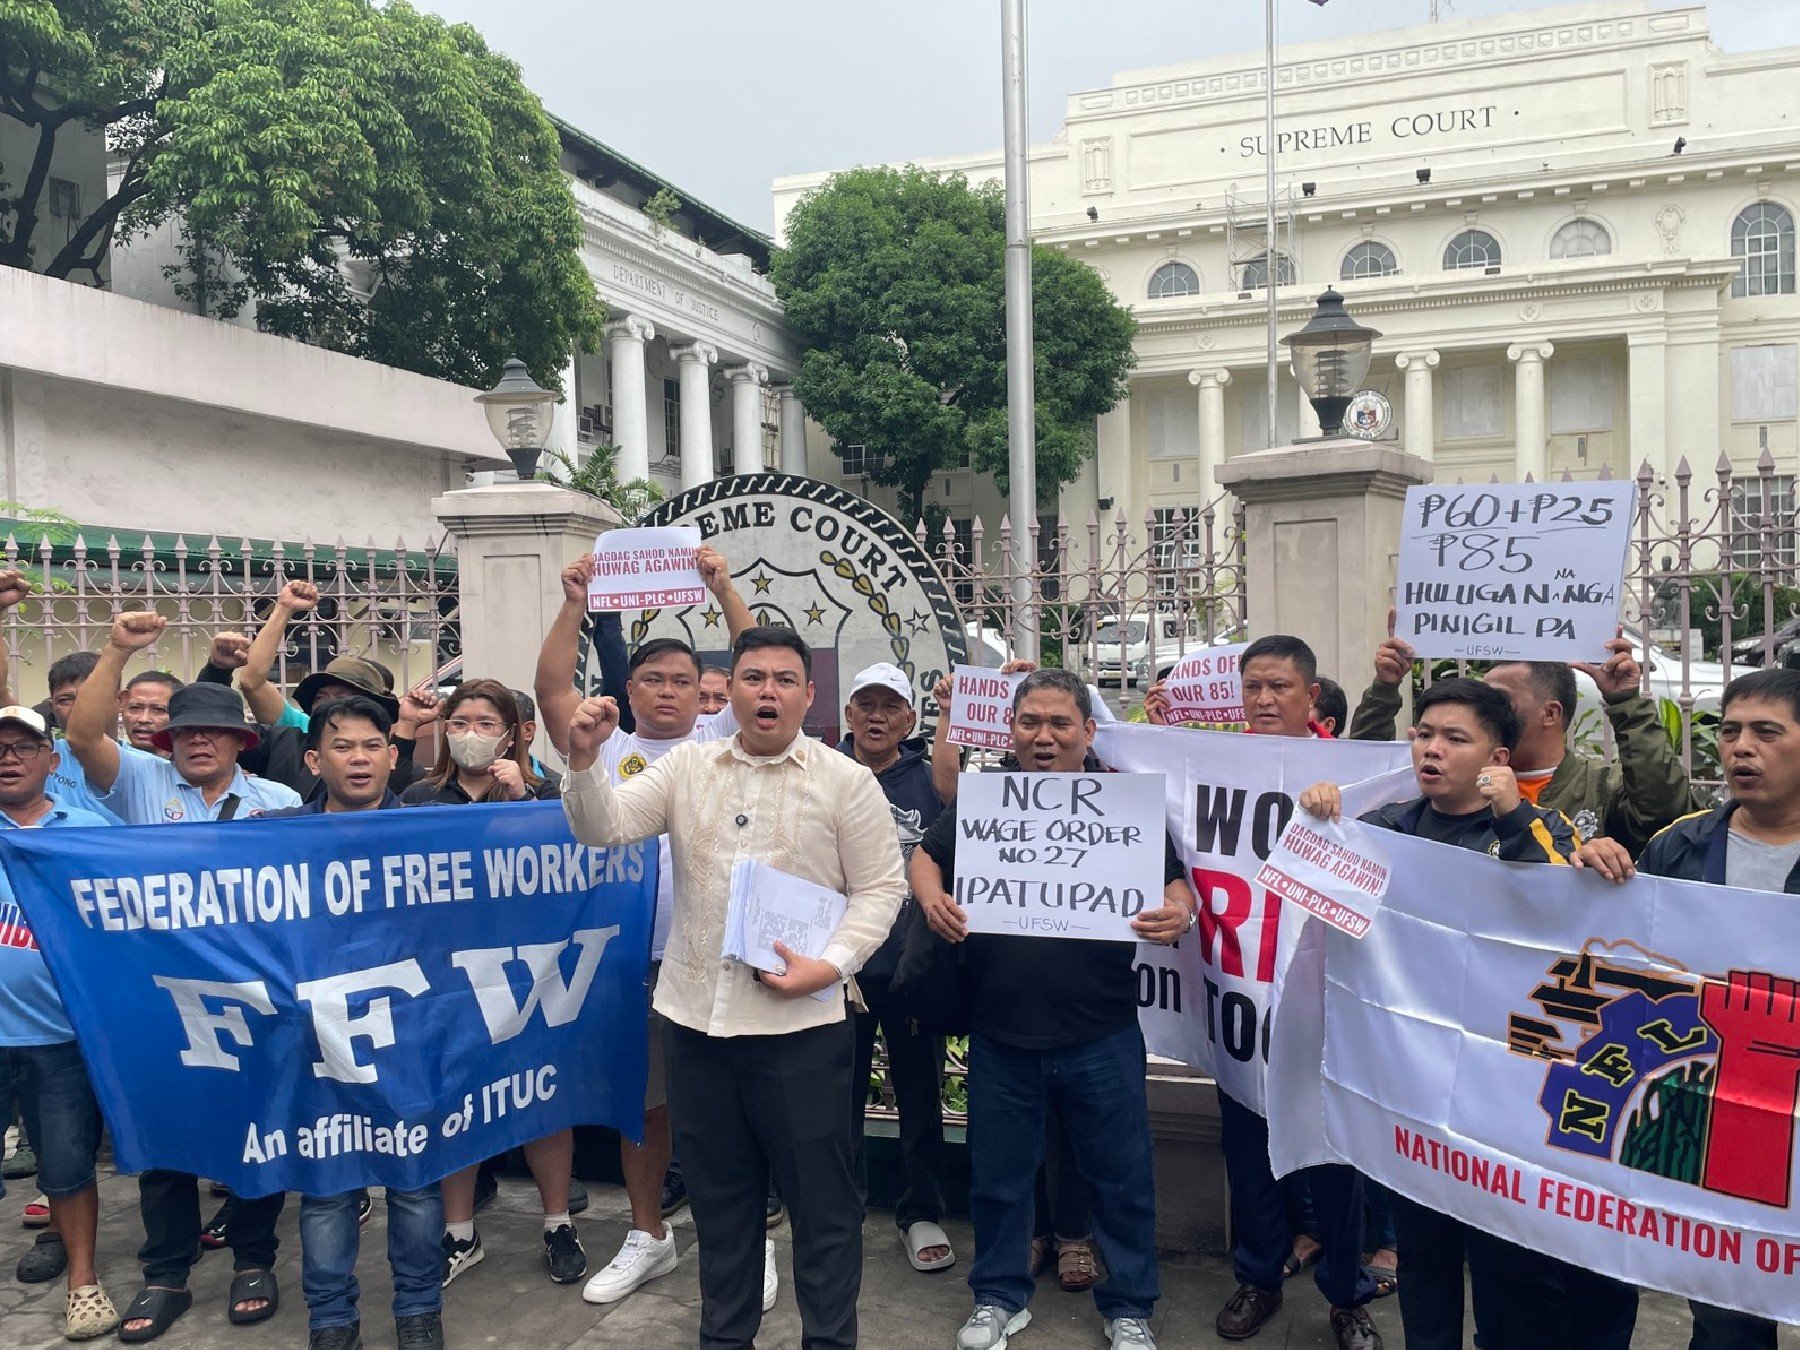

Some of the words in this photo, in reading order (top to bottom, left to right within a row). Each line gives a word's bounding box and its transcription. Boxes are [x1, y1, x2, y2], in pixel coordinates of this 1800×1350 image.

[1240, 122, 1372, 157] SUPREME
[1391, 105, 1497, 138] COURT
[613, 264, 666, 300] DEPARTMENT
[675, 291, 684, 306] OF
[633, 548, 664, 560] SAHOD
[790, 507, 907, 593] COURT
[1414, 612, 1525, 636] PINIGIL
[1536, 617, 1576, 640] PA
[958, 676, 1010, 700] HANDS
[1171, 657, 1212, 680] ANDS
[1171, 683, 1206, 702] OUR
[1209, 680, 1235, 701] 85!
[967, 702, 998, 724] OUR
[1003, 706, 1013, 726] 8
[1002, 775, 1105, 817] NCR
[961, 818, 1037, 843] WAGE
[1045, 818, 1144, 847] ORDER
[1196, 784, 1294, 861] WO
[70, 861, 310, 931] FEDERATION
[324, 857, 370, 916] OF
[383, 850, 474, 906] FREE
[484, 842, 644, 899] WORKERS
[1283, 834, 1331, 869] HUWAG
[1329, 860, 1384, 897] AGAWIN!
[957, 876, 1145, 919] IPATUPAD
[1192, 867, 1283, 983] RI
[1137, 963, 1182, 1014] on
[242, 1122, 287, 1164] An
[298, 1113, 428, 1158] affiliate
[441, 1093, 473, 1138] of
[481, 1064, 558, 1124] ITUC
[1394, 1125, 1526, 1206] NATIONAL
[1537, 1177, 1742, 1265] FEDERATION
[1756, 1238, 1800, 1276] OF
